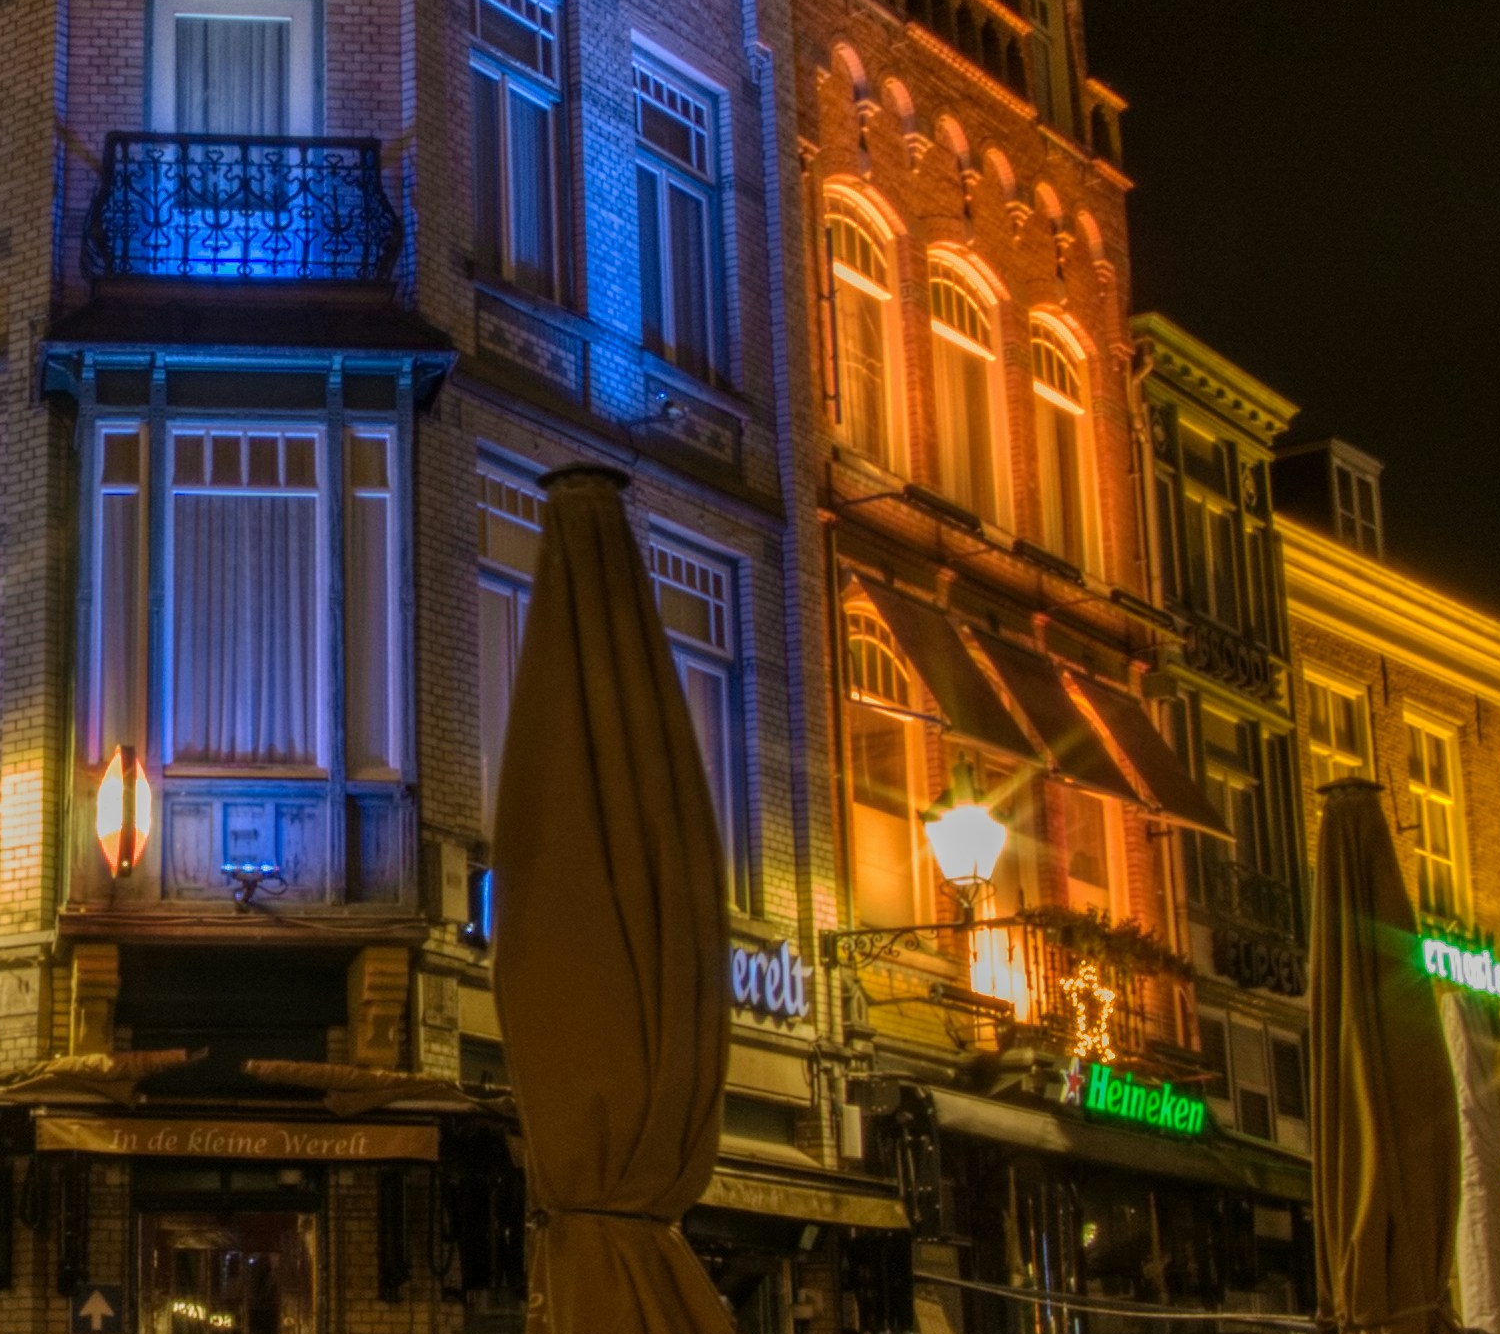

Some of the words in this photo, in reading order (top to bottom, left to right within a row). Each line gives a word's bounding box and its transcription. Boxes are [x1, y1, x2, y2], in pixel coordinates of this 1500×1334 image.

[730, 939, 813, 1017] erelt
[1087, 1062, 1205, 1134] Heineken
[109, 1127, 138, 1152] In
[147, 1128, 179, 1153] de
[187, 1129, 268, 1154] kleine
[280, 1130, 369, 1156] Werelt
